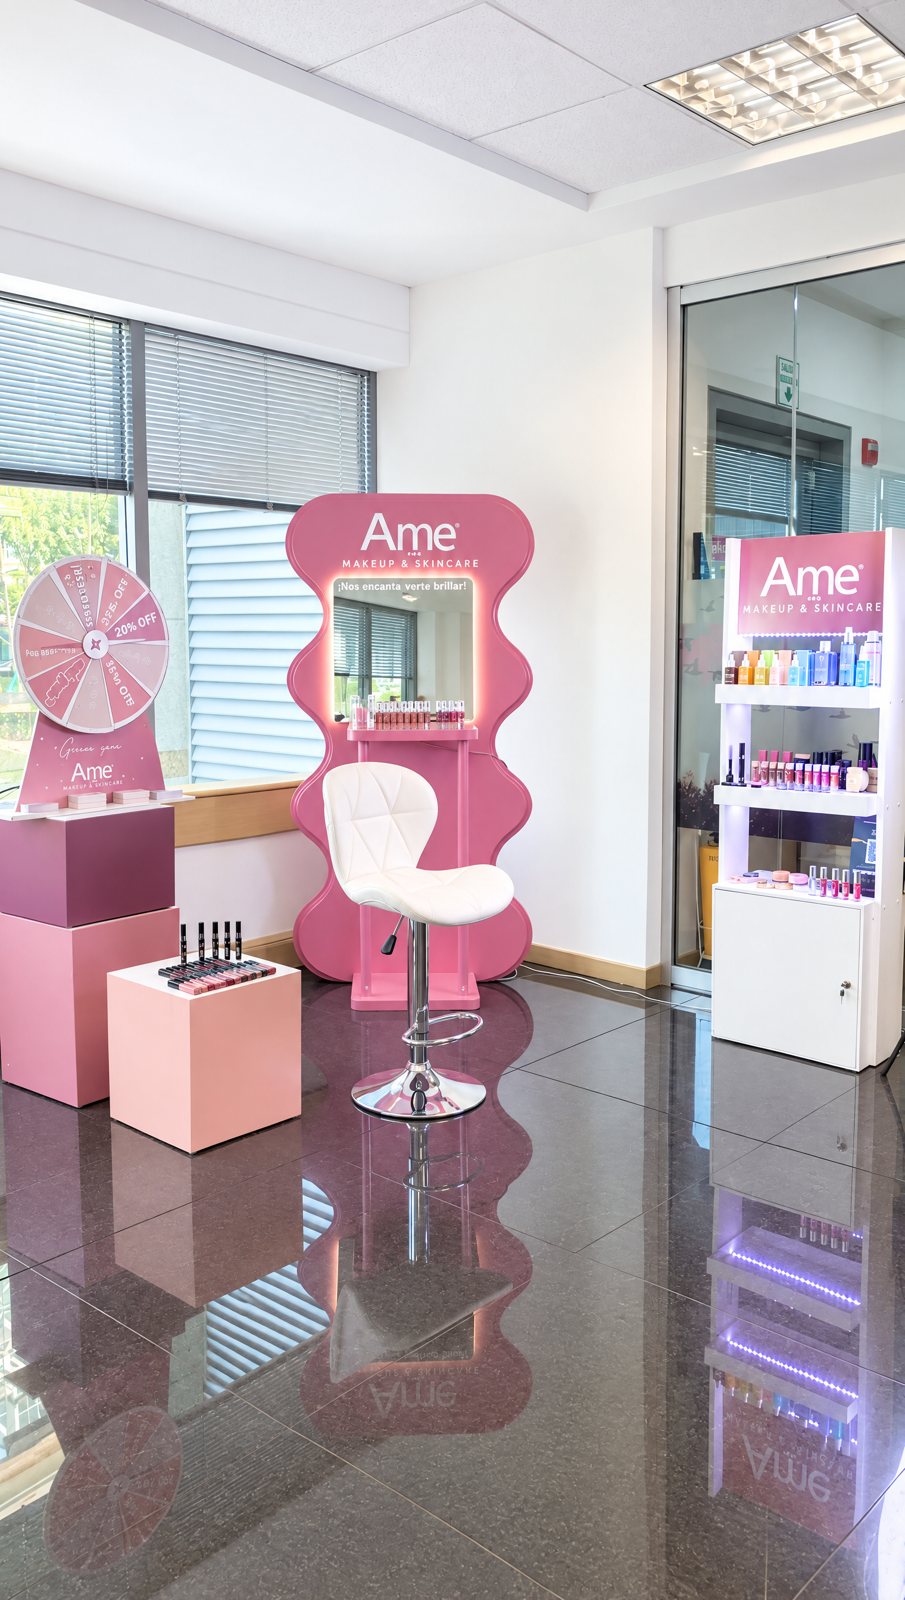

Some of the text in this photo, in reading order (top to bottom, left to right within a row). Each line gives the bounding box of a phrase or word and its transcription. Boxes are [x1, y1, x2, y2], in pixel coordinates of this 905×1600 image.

[342, 559, 480, 568] MAKEUP & SKINCARE
[338, 581, 468, 592] ¡Nos encanta verte brillar!
[742, 602, 882, 615] MAKEUP & SKINCARE
[114, 621, 137, 638] 20%
[137, 612, 157, 628] OFF
